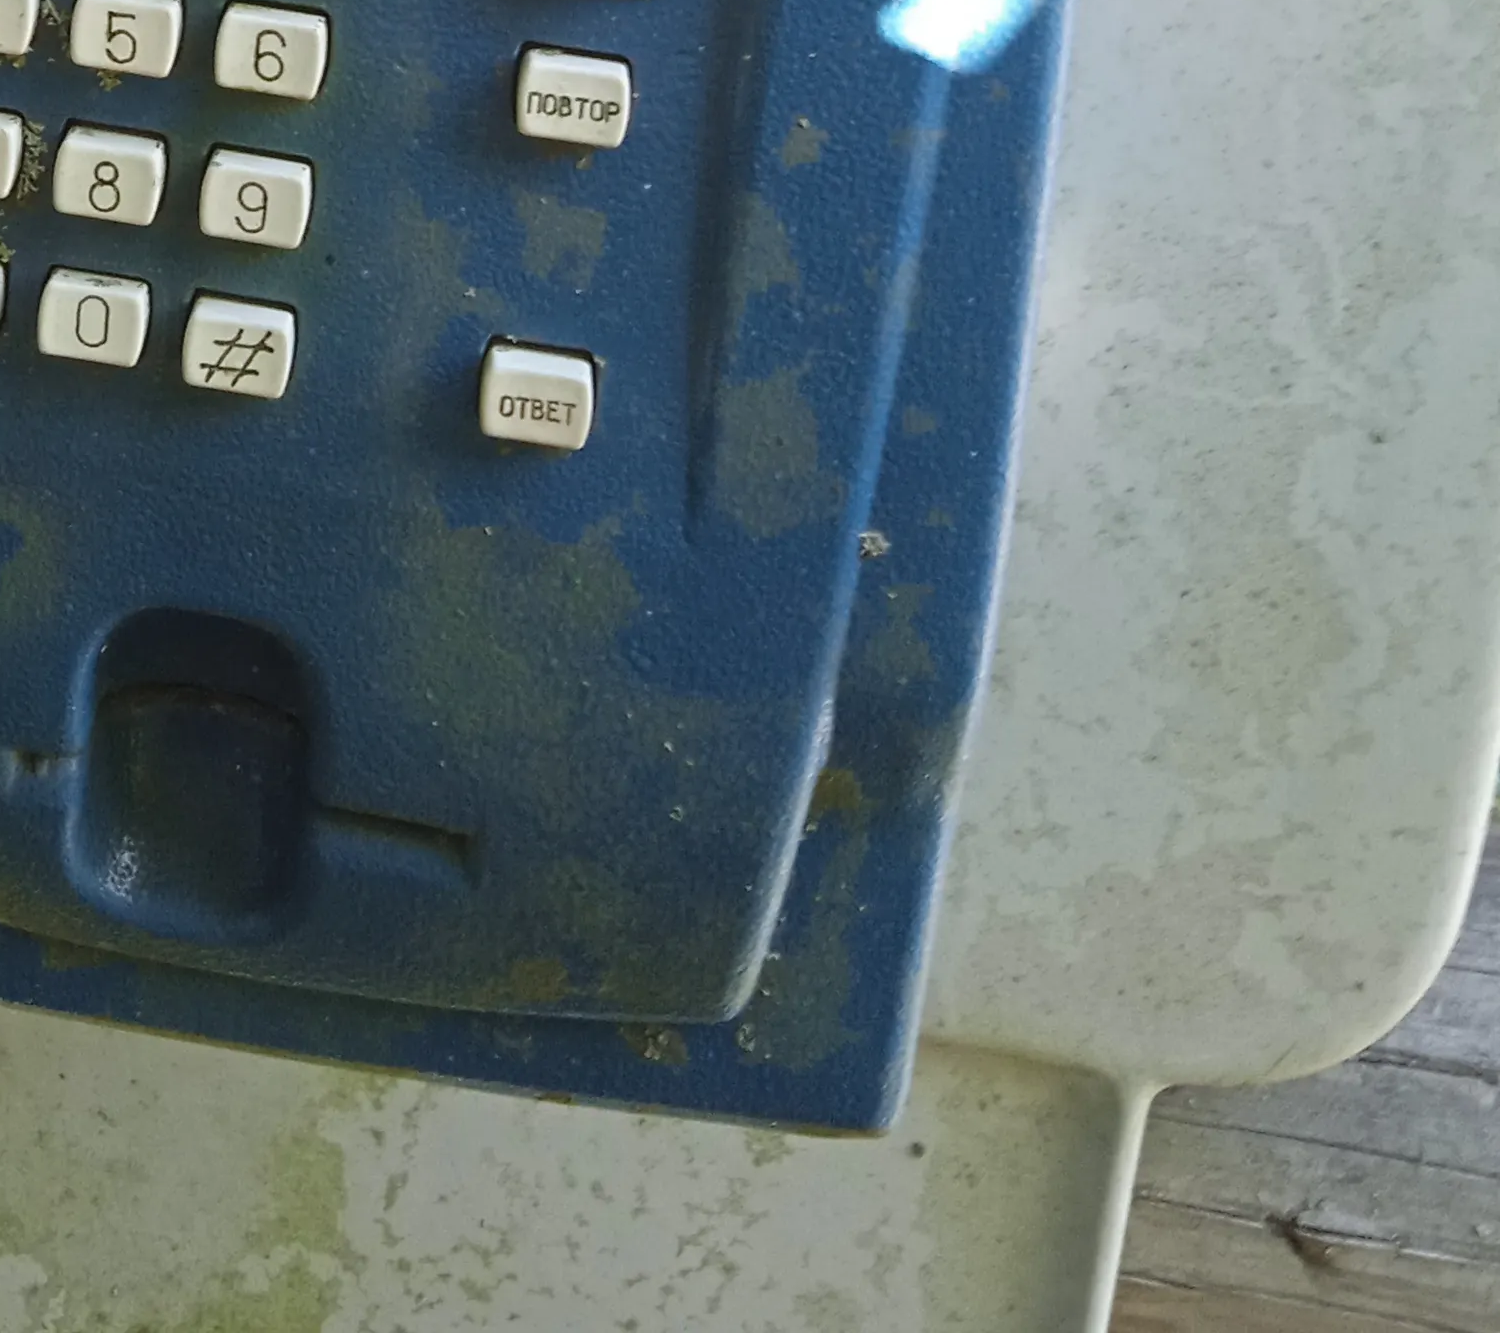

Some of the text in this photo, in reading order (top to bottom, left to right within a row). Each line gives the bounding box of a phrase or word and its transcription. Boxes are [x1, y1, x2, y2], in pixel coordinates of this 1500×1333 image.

[105, 11, 136, 64] 5
[253, 29, 287, 82] 6
[527, 91, 621, 123] ПОВТОР
[88, 161, 121, 212] 8
[234, 182, 268, 233] 9
[75, 295, 109, 348] 0
[500, 395, 577, 426] ОТВЕТ
